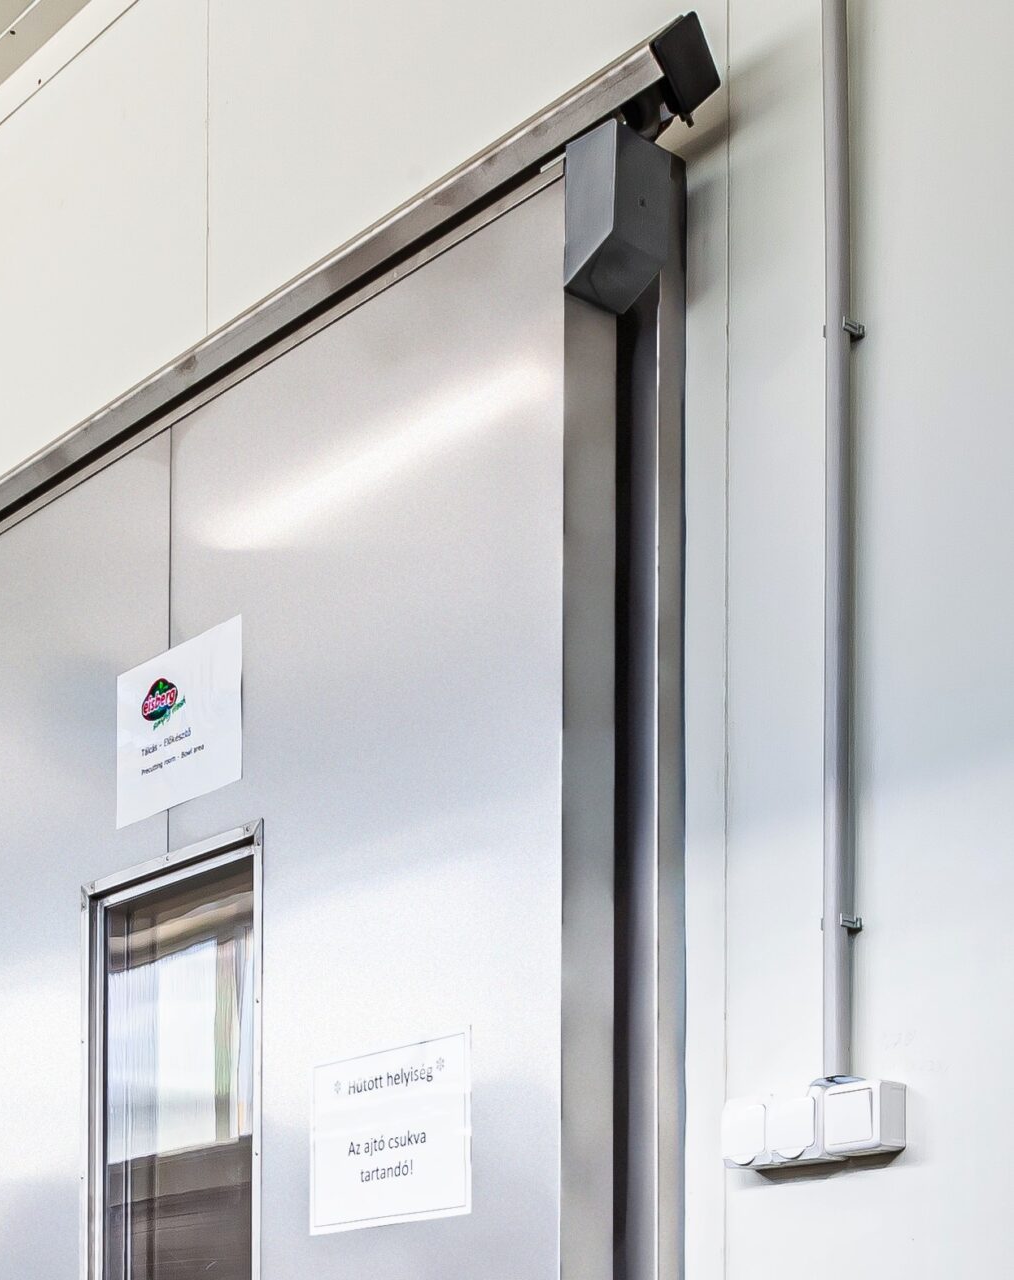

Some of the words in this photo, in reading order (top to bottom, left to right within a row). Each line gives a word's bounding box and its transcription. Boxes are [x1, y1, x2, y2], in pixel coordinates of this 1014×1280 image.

[143, 687, 177, 715] eisberg
[164, 756, 177, 766] room
[181, 748, 193, 759] Bowl
[194, 744, 205, 754] area
[386, 1064, 434, 1087] helyiség
[348, 1141, 361, 1156] Az
[363, 1135, 385, 1156] ajtó
[388, 1130, 427, 1149] csukva
[360, 1159, 414, 1183] tartandó!
